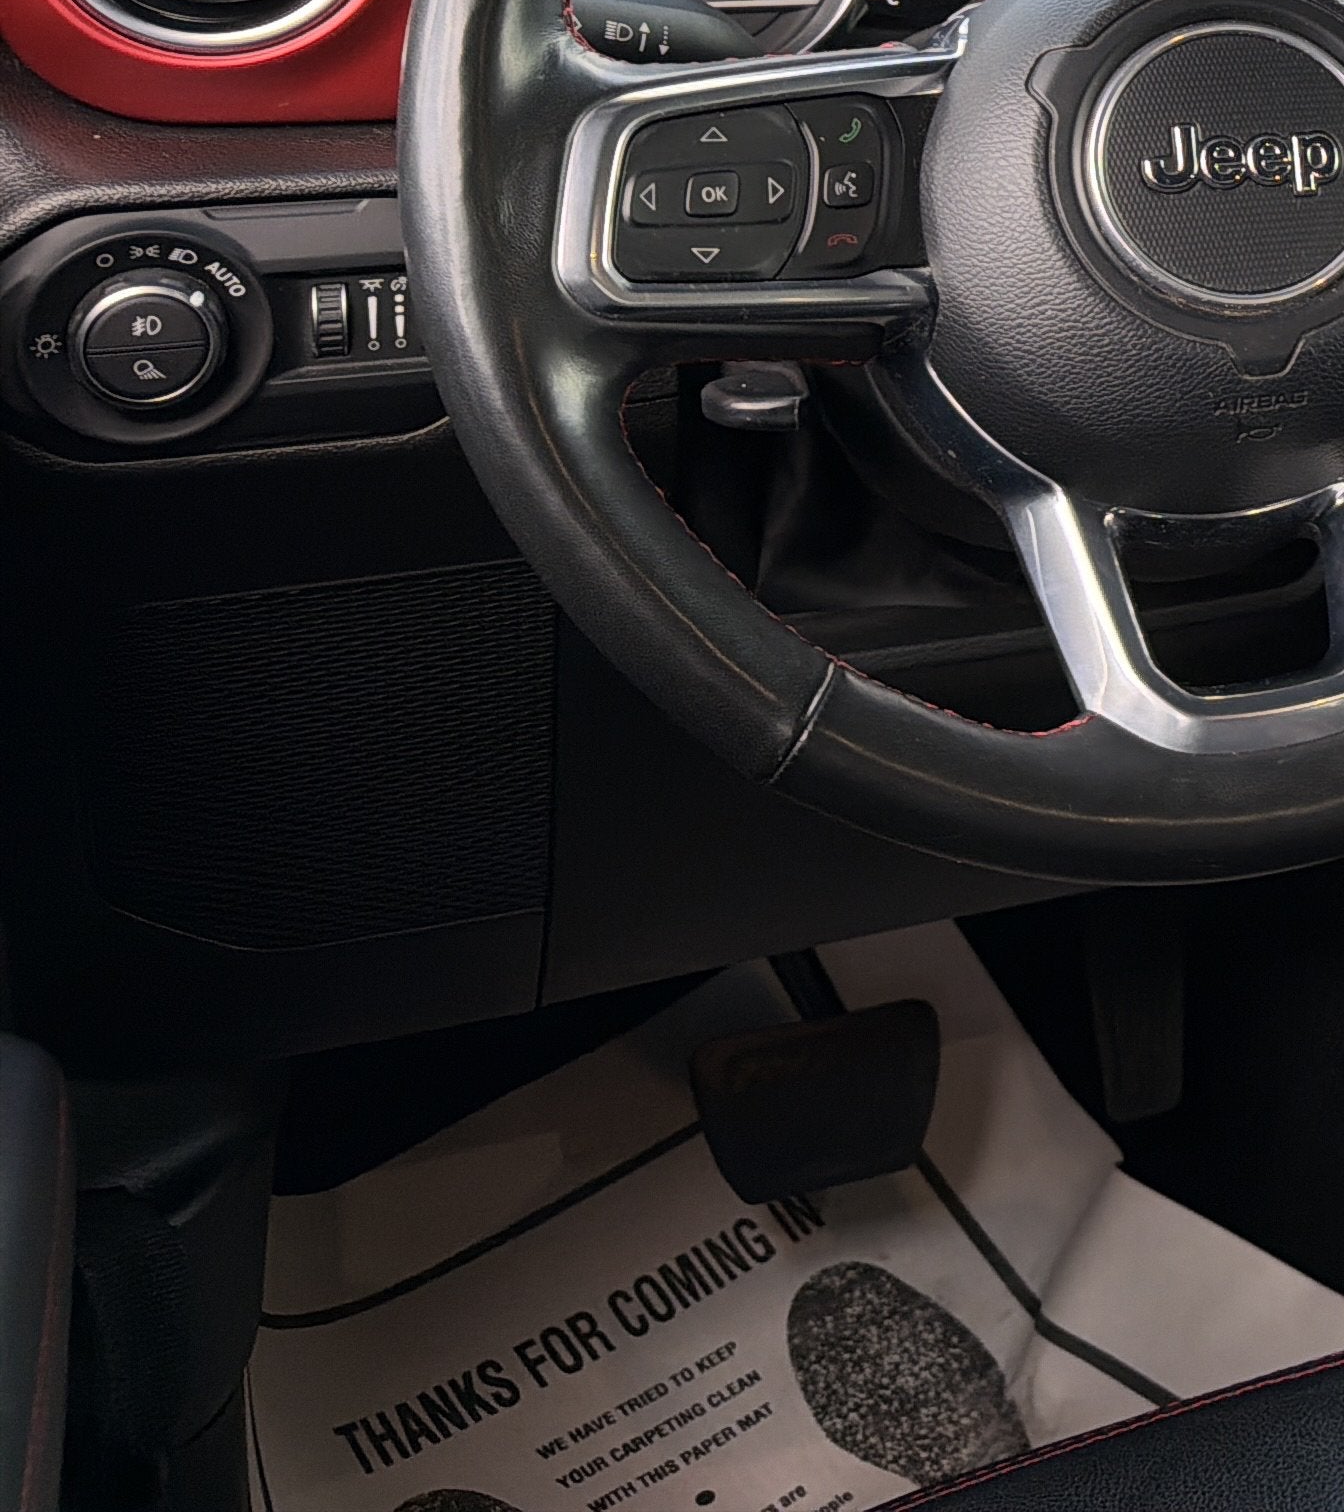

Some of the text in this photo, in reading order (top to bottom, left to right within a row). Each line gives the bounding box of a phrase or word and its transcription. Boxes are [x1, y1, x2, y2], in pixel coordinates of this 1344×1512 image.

[701, 185, 728, 202] OK
[1141, 122, 1343, 197] Jeep
[204, 261, 246, 298] AUTO
[1214, 392, 1308, 416] AIRBAG
[333, 1196, 826, 1475] THANKS FOR COMING IN
[535, 1341, 738, 1460] WE HAVE TRIED TO KEEP
[555, 1369, 762, 1489] YOUR CARPETING CLEAN
[587, 1401, 774, 1512] WITH THIS PAPER MAT
[779, 1485, 806, 1508] are
